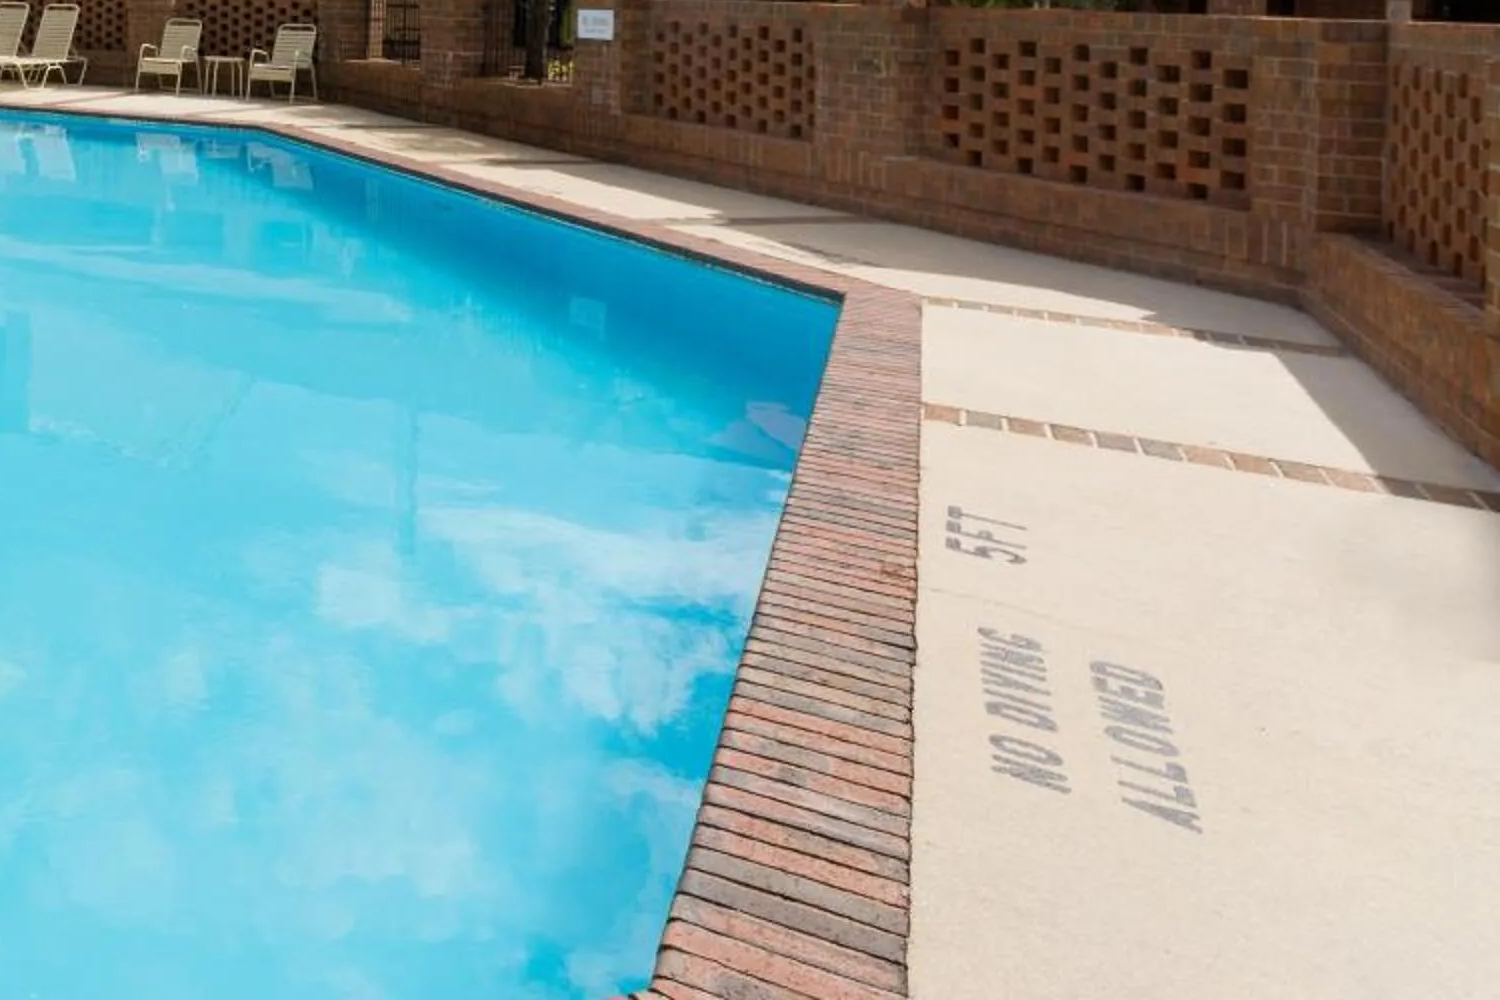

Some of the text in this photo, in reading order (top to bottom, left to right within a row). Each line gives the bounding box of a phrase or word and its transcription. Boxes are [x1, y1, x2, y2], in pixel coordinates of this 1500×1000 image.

[945, 505, 1028, 565] 5FT
[977, 626, 1072, 795] NO DIVING
[1089, 660, 1203, 834] ALLOWED
